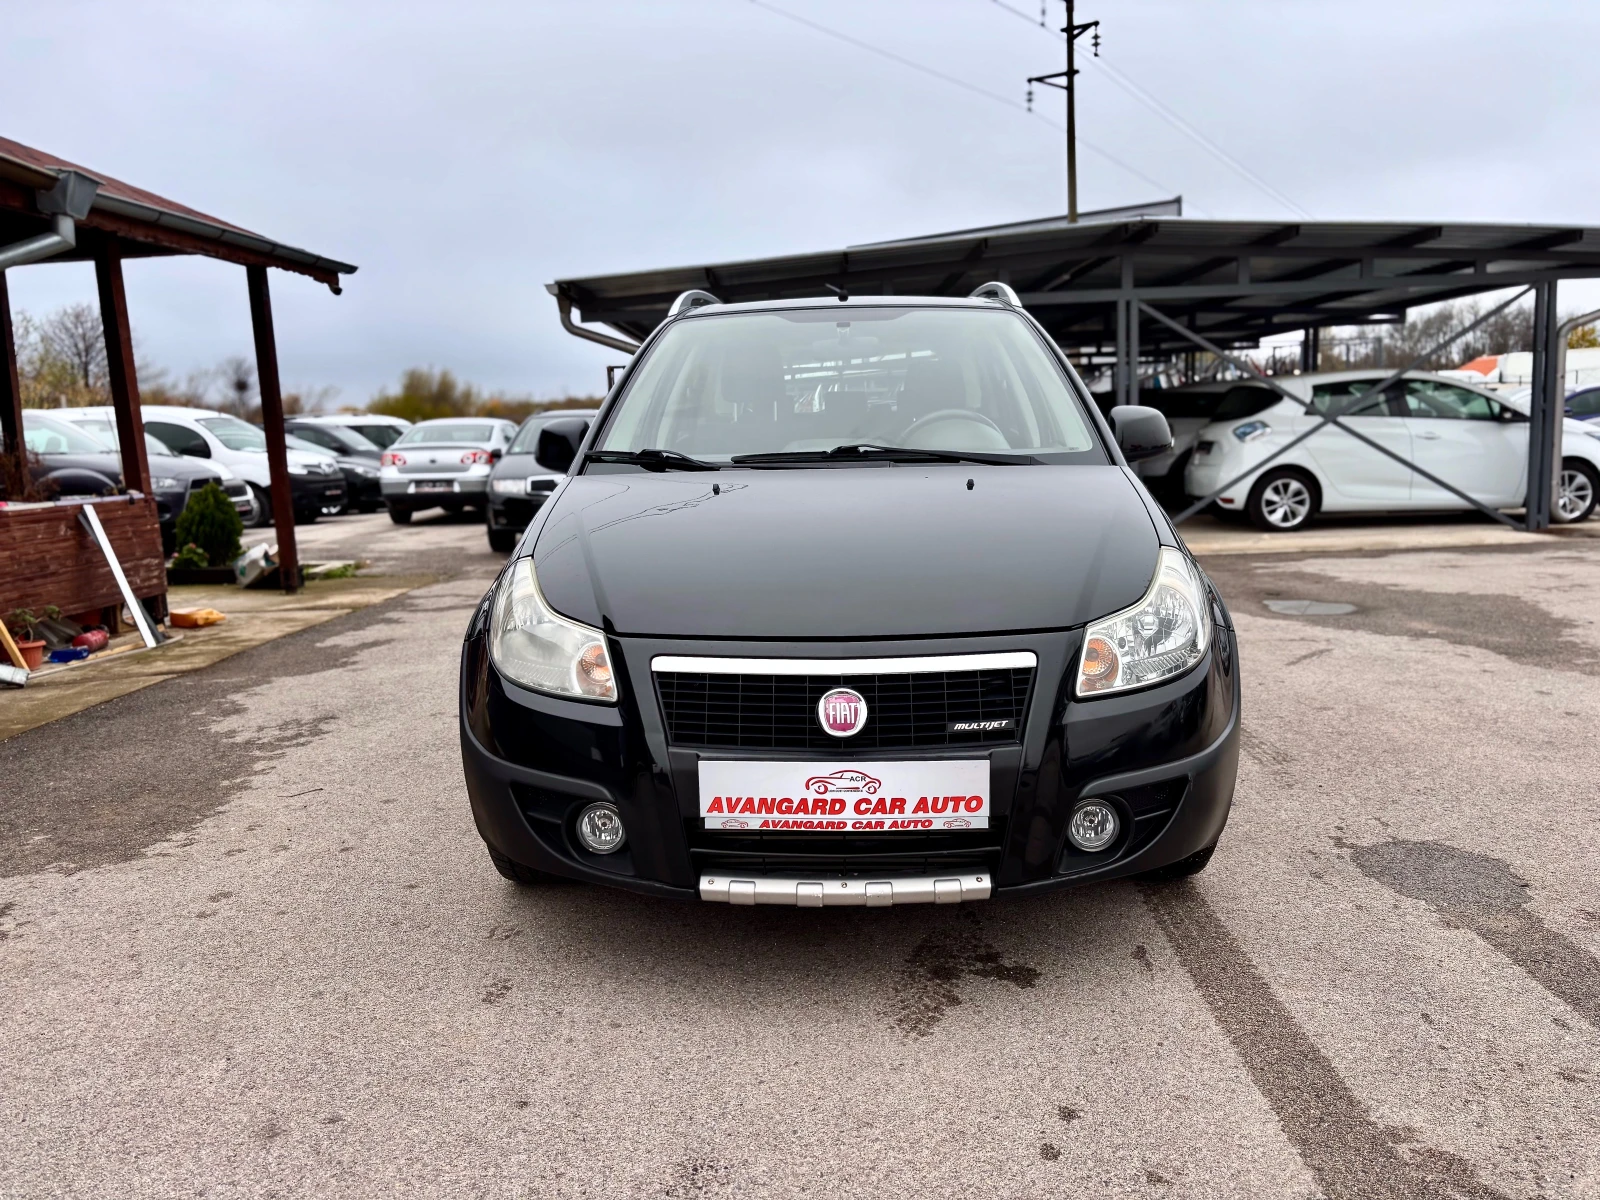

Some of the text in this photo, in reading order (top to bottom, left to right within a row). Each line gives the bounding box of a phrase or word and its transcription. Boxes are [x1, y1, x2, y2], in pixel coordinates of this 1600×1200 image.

[829, 702, 857, 724] FIAT
[953, 720, 1009, 730] MULTIJET
[706, 795, 984, 815] AVANGARD CAR AUTO
[758, 818, 934, 830] AVANGARD CAR AUTO
